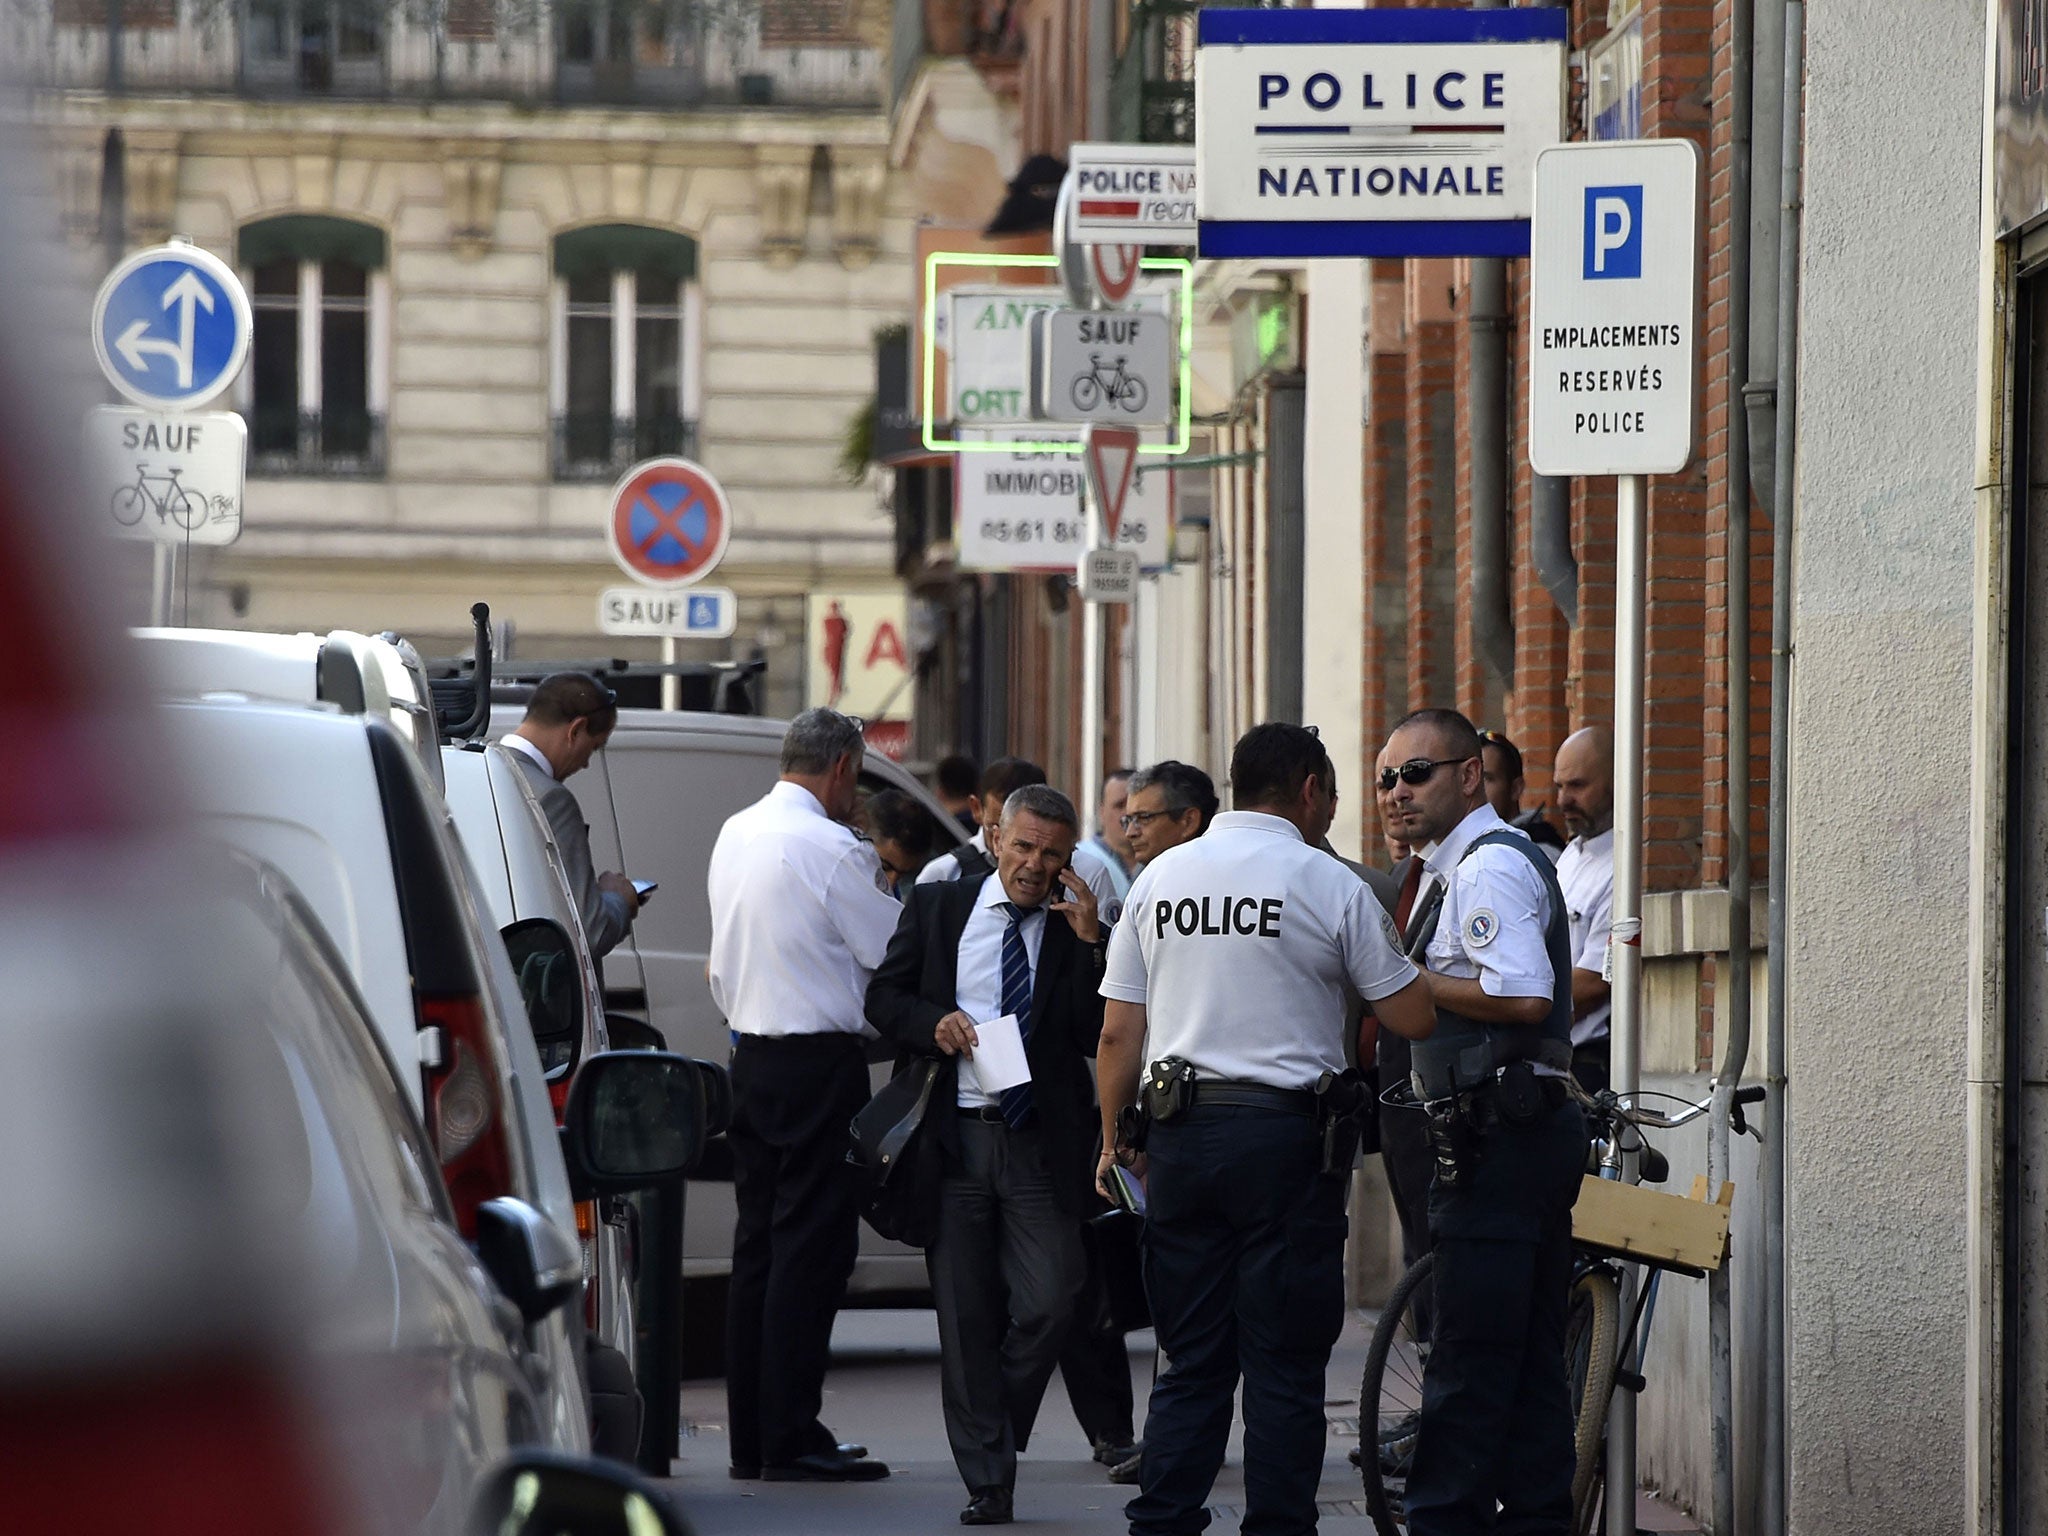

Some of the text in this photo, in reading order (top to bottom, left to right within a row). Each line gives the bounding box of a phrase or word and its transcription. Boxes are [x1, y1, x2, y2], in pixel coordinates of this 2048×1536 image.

[1258, 72, 1505, 112] POLICE
[1079, 171, 1162, 194] POLICE
[1258, 166, 1504, 197] NATIONALE
[1594, 196, 1631, 272] P
[1078, 317, 1142, 345] SAUF
[1543, 324, 1681, 349] EMPLACEMENTS
[1559, 365, 1663, 393] RESERVÉS
[1575, 412, 1645, 434] POLICE
[122, 422, 203, 453] SAUF
[608, 599, 682, 625] SAUF
[1155, 896, 1284, 940] POLICE
